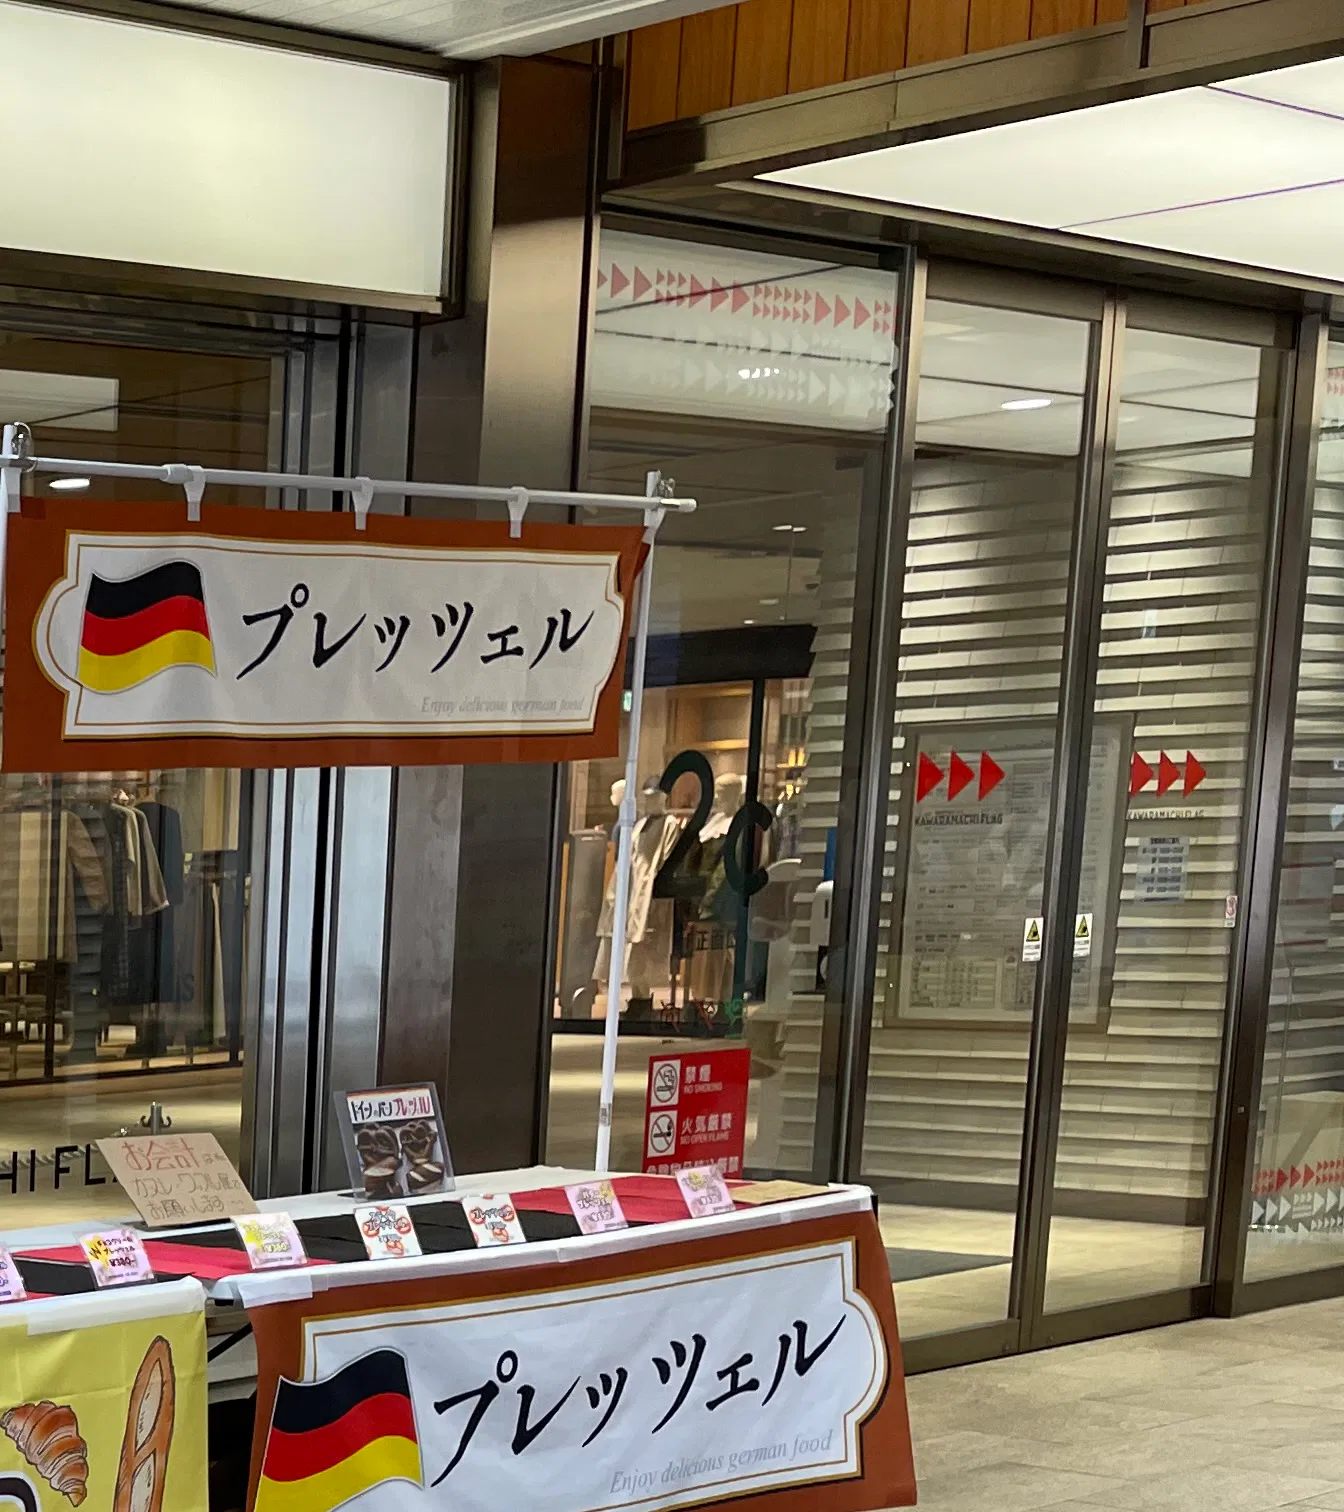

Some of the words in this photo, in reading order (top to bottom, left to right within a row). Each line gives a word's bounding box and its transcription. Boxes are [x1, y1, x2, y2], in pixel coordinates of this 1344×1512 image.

[236, 583, 596, 681] プレッツェル
[421, 696, 454, 716] Enjoy
[511, 698, 556, 716] german
[556, 697, 584, 716] food
[431, 1314, 847, 1488] プレッツェル
[610, 1469, 658, 1495] Enjoy
[661, 1453, 724, 1483] delicious
[728, 1443, 787, 1472] german
[791, 1429, 833, 1462] food
